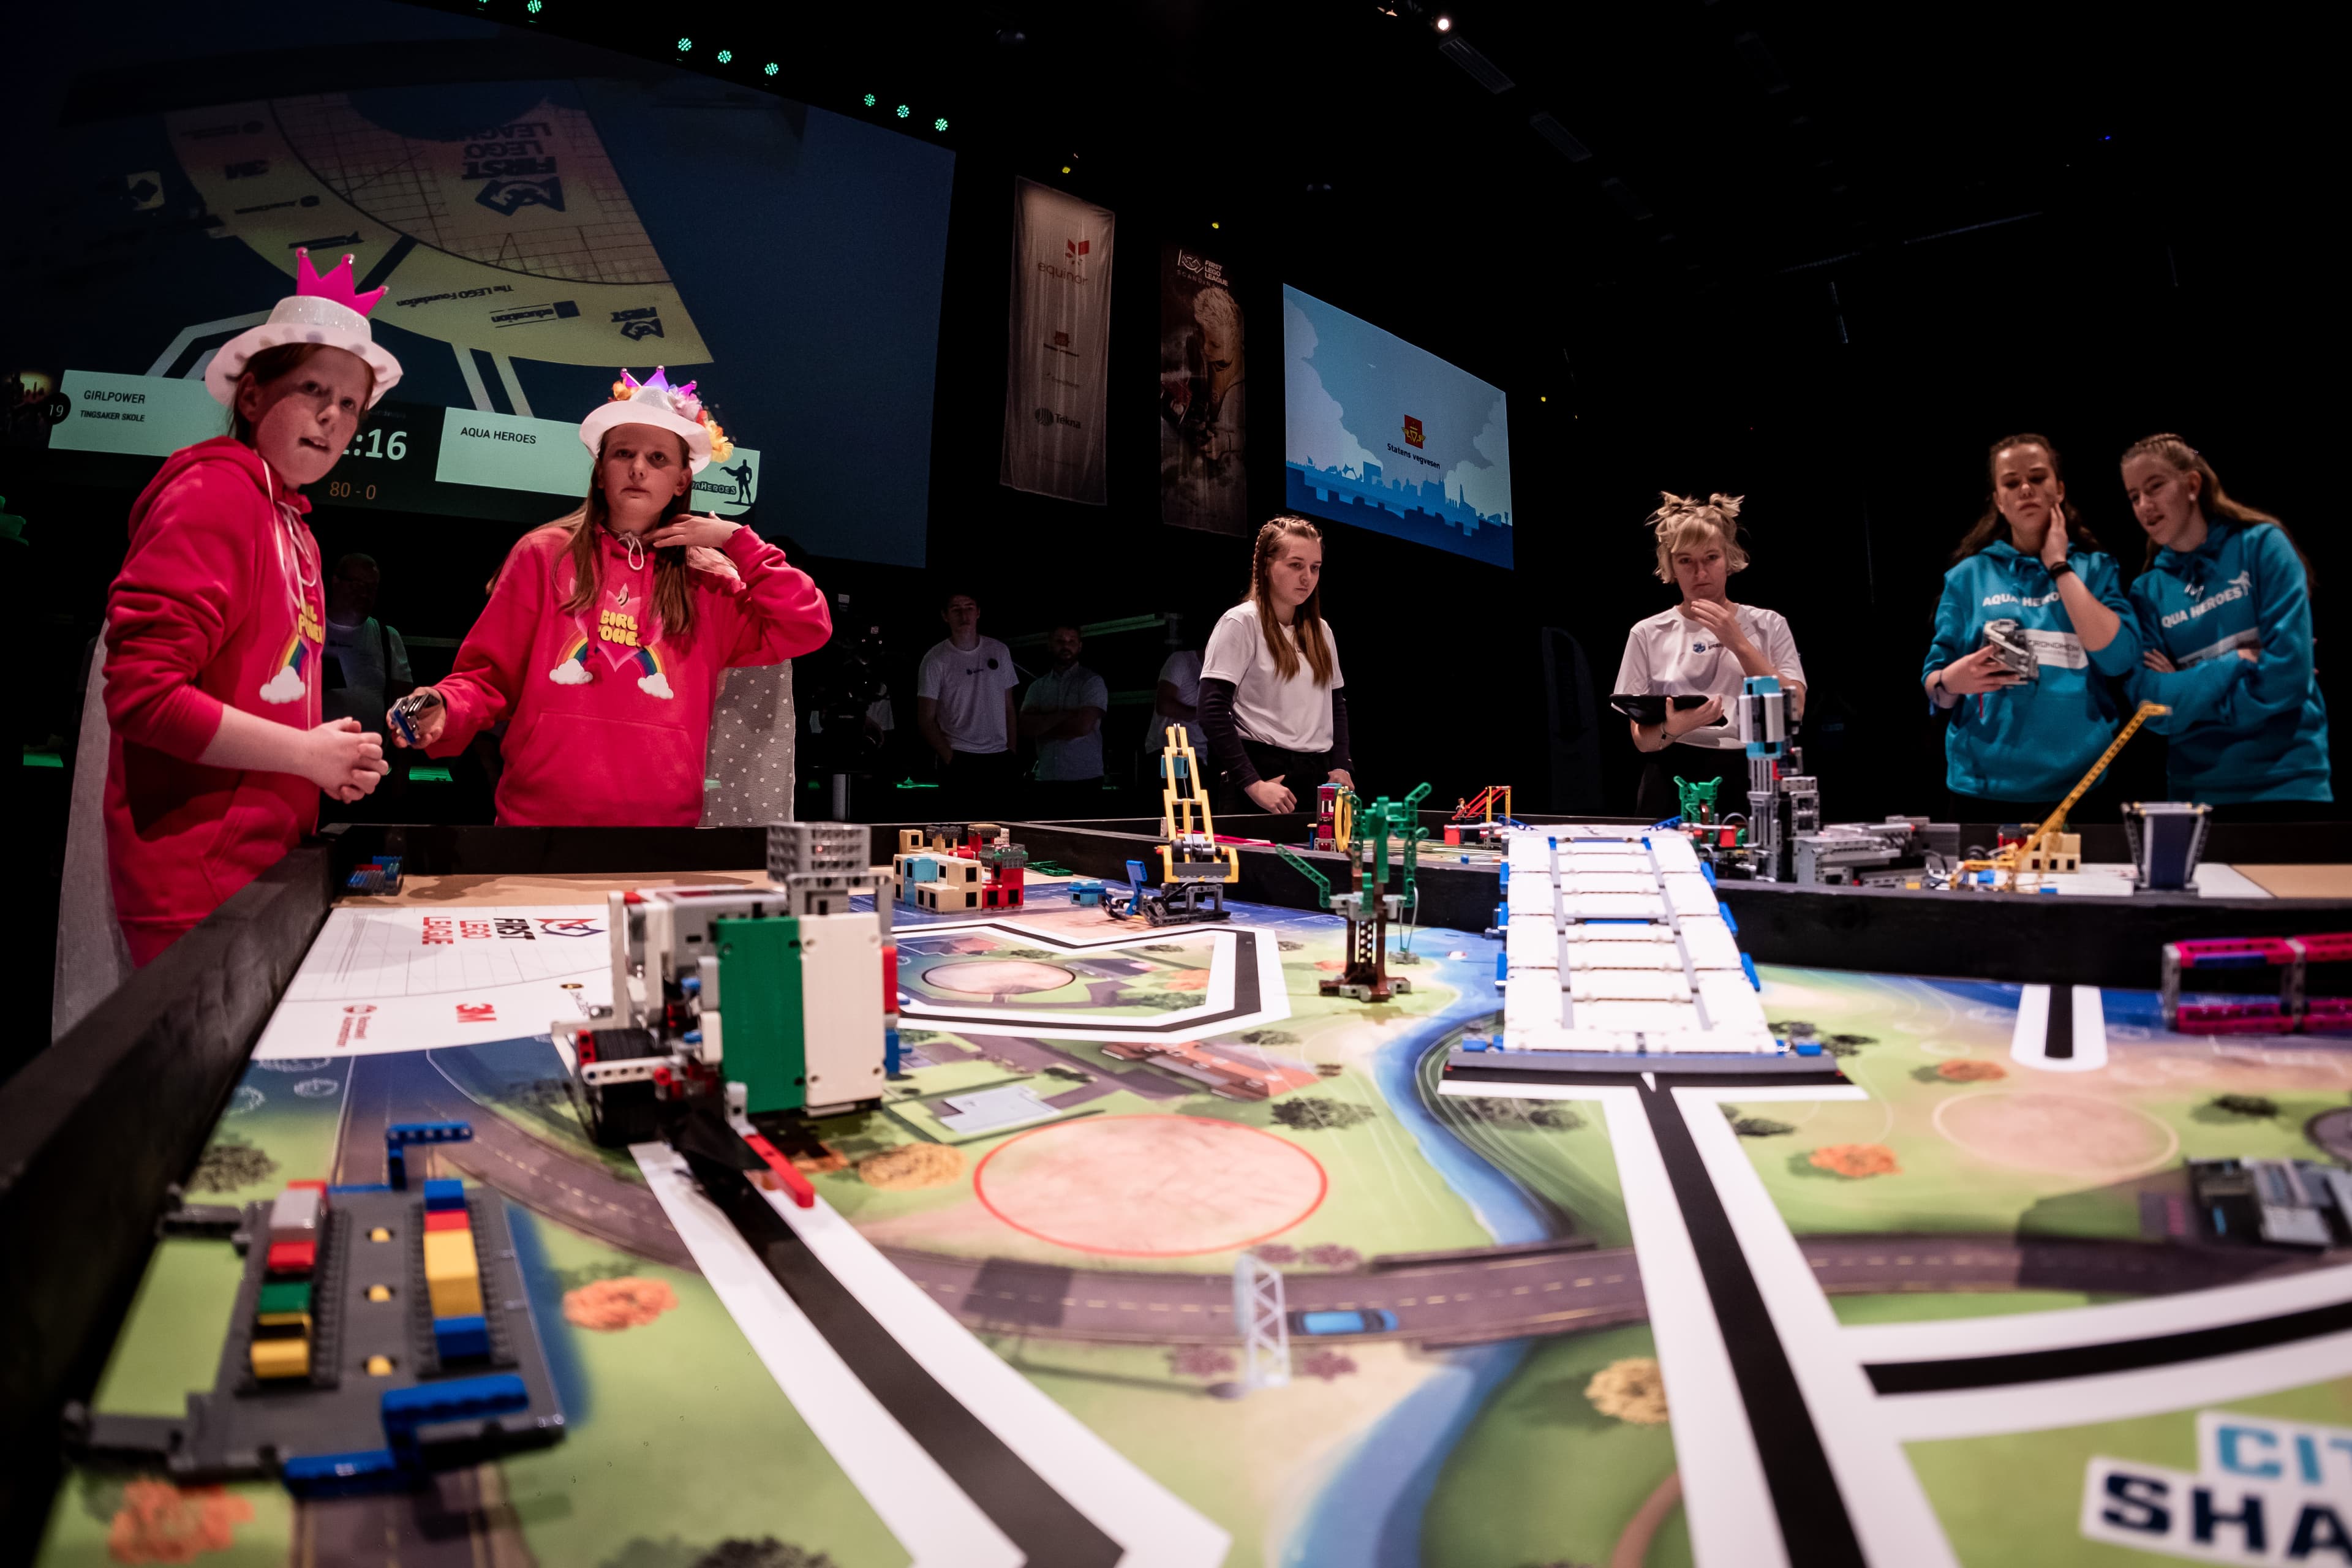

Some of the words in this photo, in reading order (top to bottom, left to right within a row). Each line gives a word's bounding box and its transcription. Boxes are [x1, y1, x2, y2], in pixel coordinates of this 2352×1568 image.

[1038, 262, 1088, 285] equinor
[1205, 260, 1223, 271] FIRST
[1205, 265, 1221, 277] LEGO
[1205, 272, 1228, 287] LEAGUE
[459, 287, 492, 299] LEGO
[83, 390, 146, 405] GIRLPOWER
[48, 403, 64, 418] 19
[80, 409, 121, 420] TINGSAKER
[121, 413, 145, 422] SKOLE
[1055, 414, 1081, 429] Tekna
[461, 426, 490, 439] AQUA
[492, 430, 537, 444] HEROES
[341, 428, 408, 461] :16
[1387, 443, 1411, 458] Statens
[1412, 454, 1441, 470] vegvesen
[329, 481, 352, 499] 80
[365, 484, 377, 500] 0
[1982, 594, 2019, 607] AQUA
[2162, 610, 2189, 628] QUA
[2190, 587, 2244, 619] HEROES
[597, 625, 643, 648] OWE
[421, 917, 454, 945] LEAGUE
[459, 920, 492, 939] LEGO
[494, 918, 536, 940] FIRST
[456, 1003, 497, 1023] 3M
